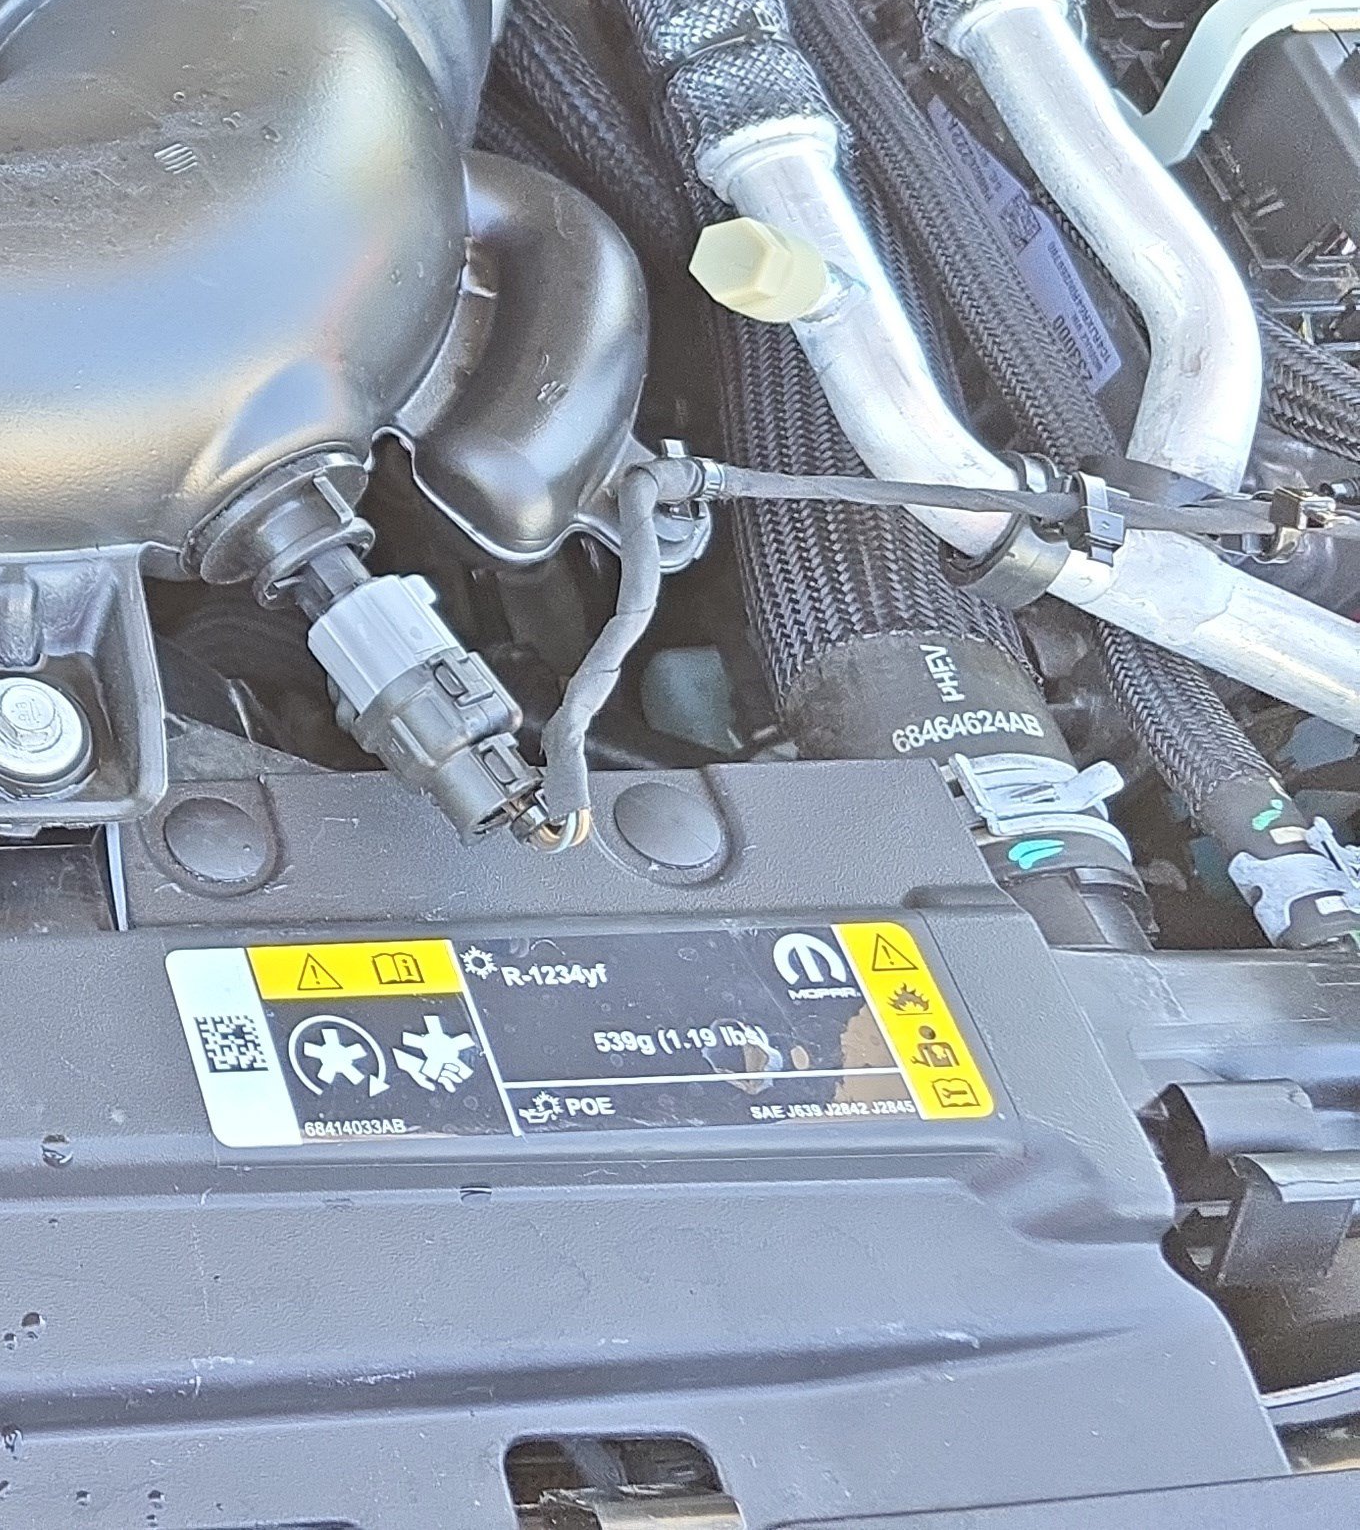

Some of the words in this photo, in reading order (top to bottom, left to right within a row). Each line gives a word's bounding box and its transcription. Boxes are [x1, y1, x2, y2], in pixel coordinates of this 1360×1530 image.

[920, 644, 965, 703] PHEV
[891, 710, 1044, 753] 68464624AB
[501, 963, 608, 988] R-1234yf
[593, 1030, 656, 1055] 539g
[658, 1027, 717, 1054] (1.19
[724, 1024, 768, 1047] lbs)
[566, 1097, 615, 1115] POE
[750, 1105, 785, 1119] SAE
[304, 1118, 406, 1137] 68414033AB
